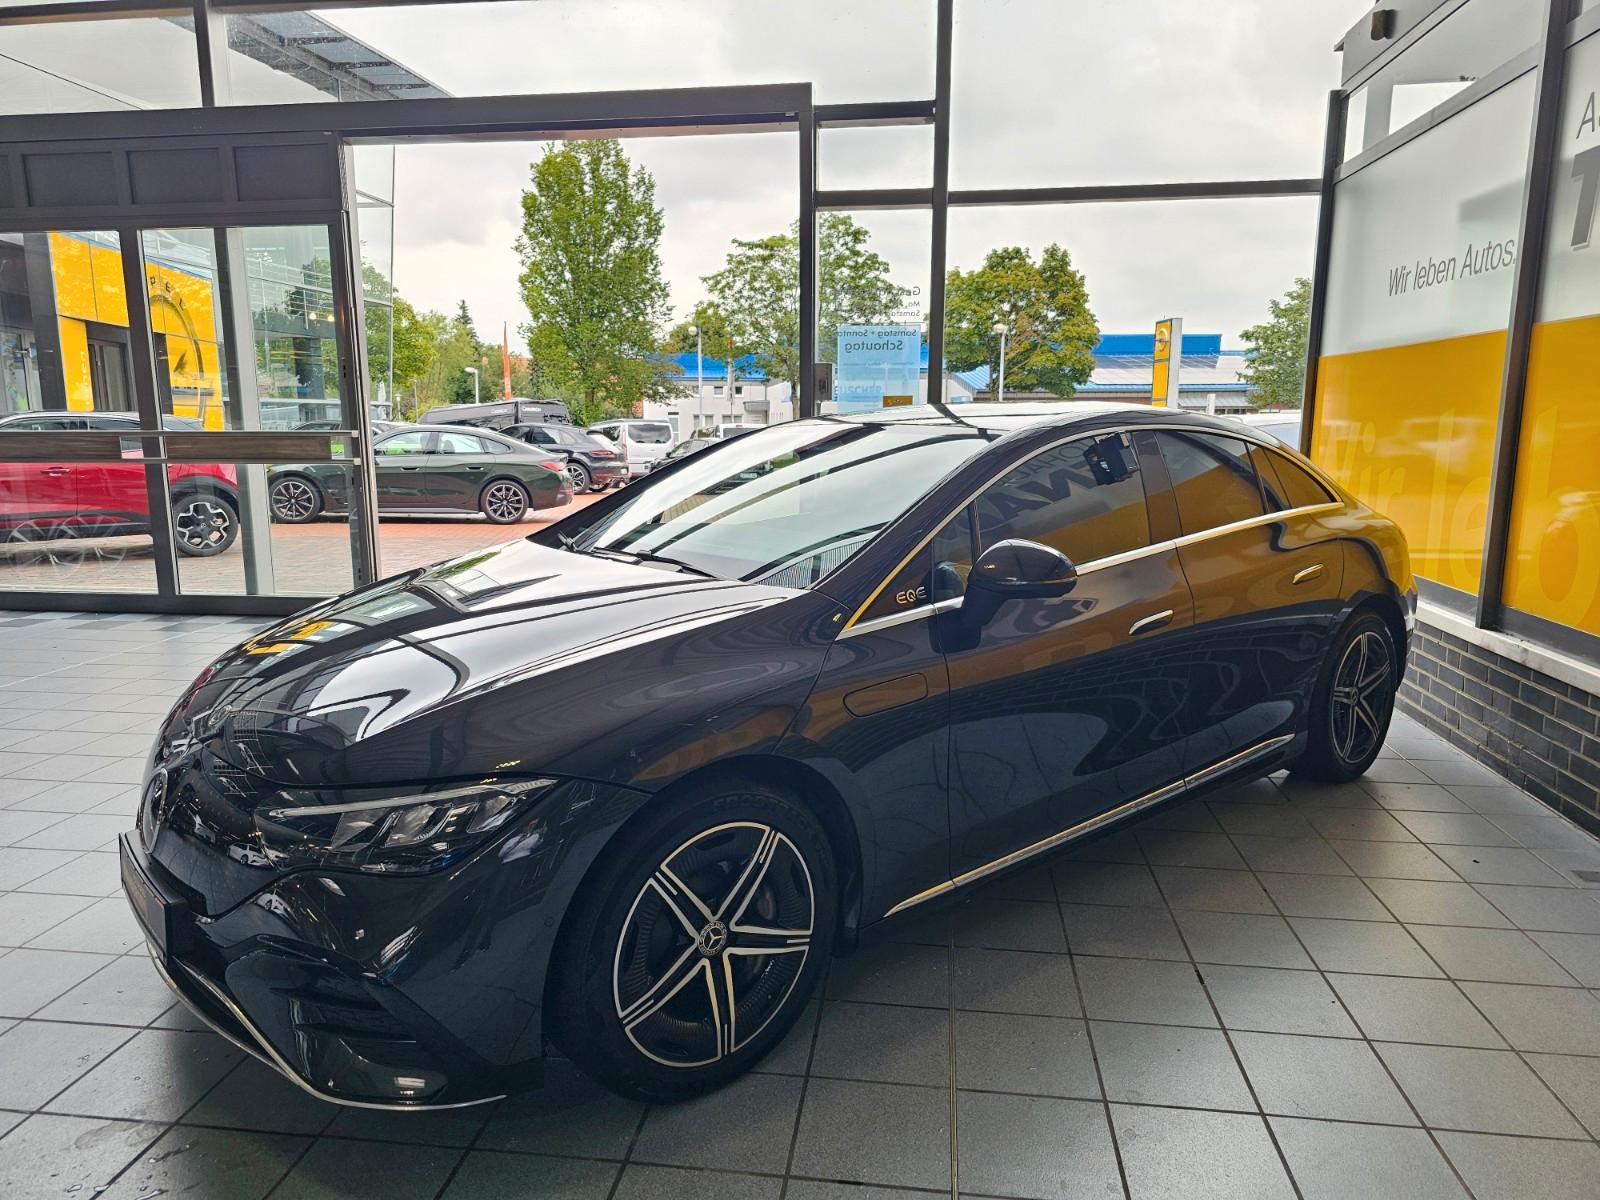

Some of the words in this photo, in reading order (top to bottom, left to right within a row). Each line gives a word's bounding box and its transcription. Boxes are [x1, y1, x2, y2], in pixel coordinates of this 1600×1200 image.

[1389, 265, 1411, 296] Wir
[1413, 257, 1456, 290] leben
[896, 586, 927, 604] EQE
